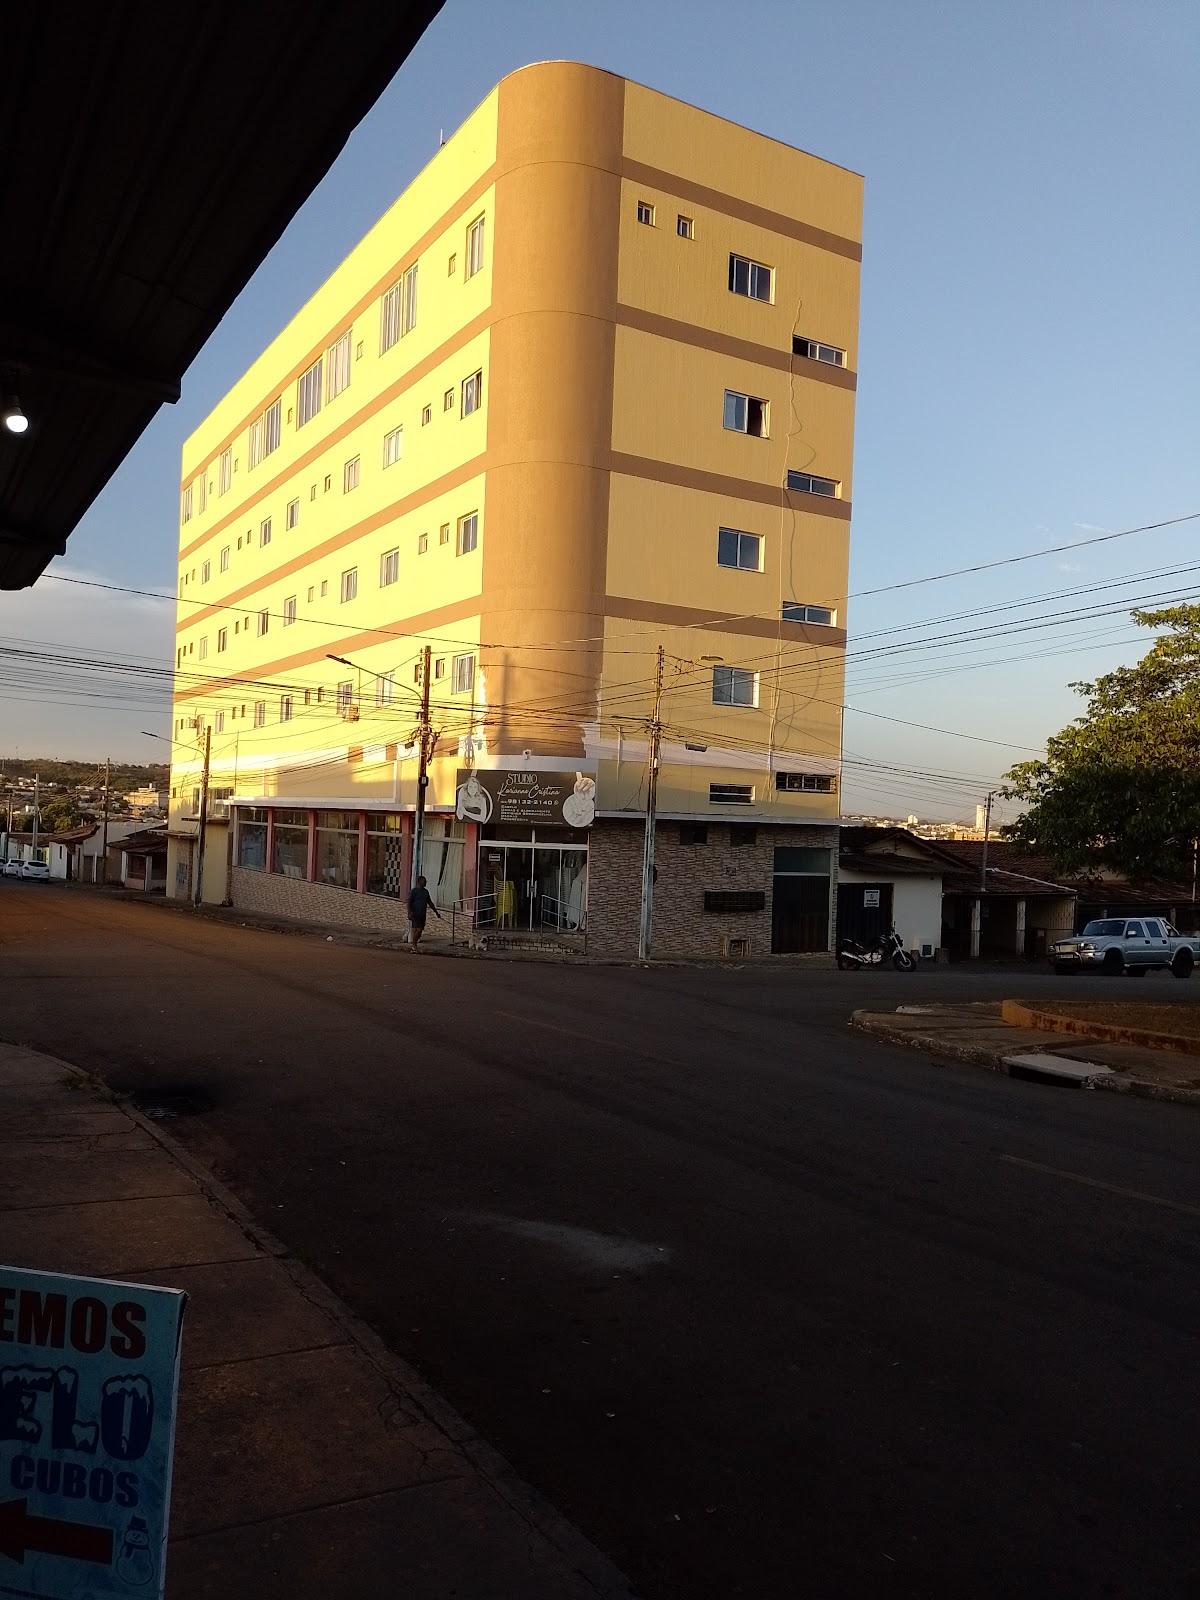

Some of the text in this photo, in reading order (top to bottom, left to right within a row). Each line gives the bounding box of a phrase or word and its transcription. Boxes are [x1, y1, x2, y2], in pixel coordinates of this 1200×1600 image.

[506, 773, 537, 785] STUDIO
[528, 784, 564, 799] Cristina
[10, 1454, 140, 1508] CUBOS
